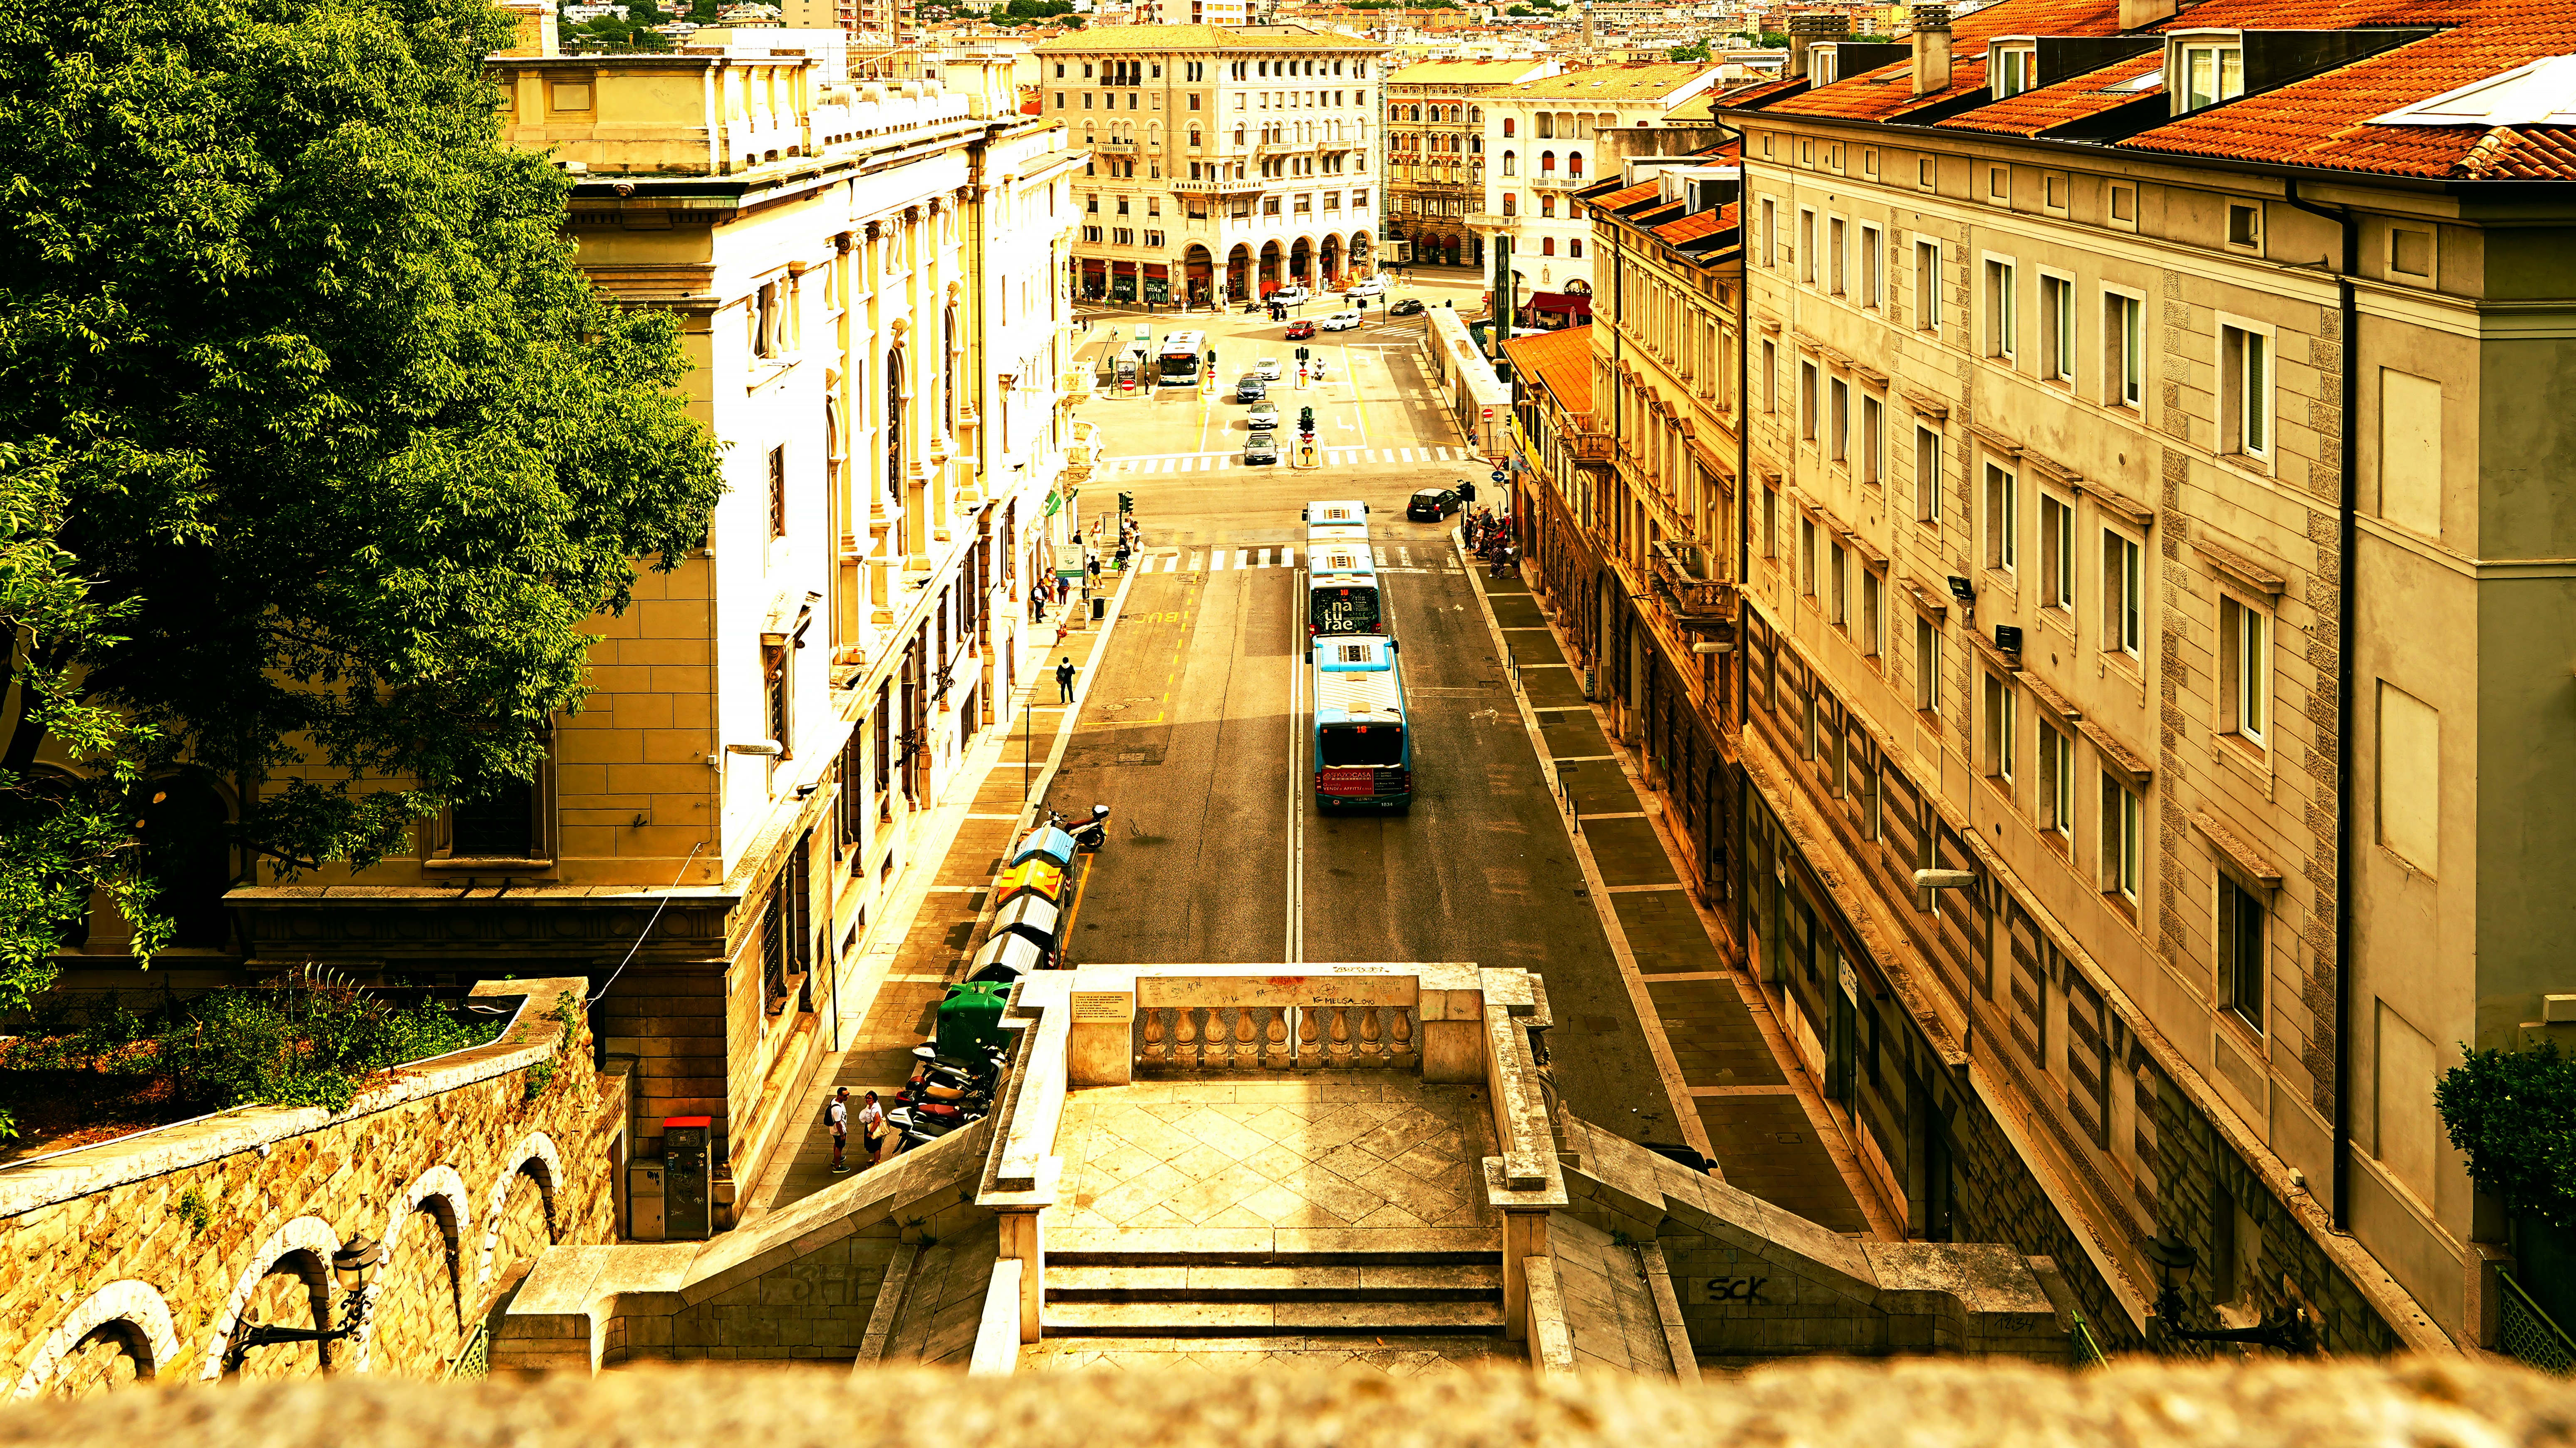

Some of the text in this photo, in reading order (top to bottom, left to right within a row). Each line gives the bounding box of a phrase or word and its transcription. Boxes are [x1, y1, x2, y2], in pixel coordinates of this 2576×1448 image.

[1333, 602, 1352, 611] na
[1324, 609, 1342, 621] tu
[1325, 620, 1353, 630] rae
[1707, 1276, 1770, 1304] SCK
